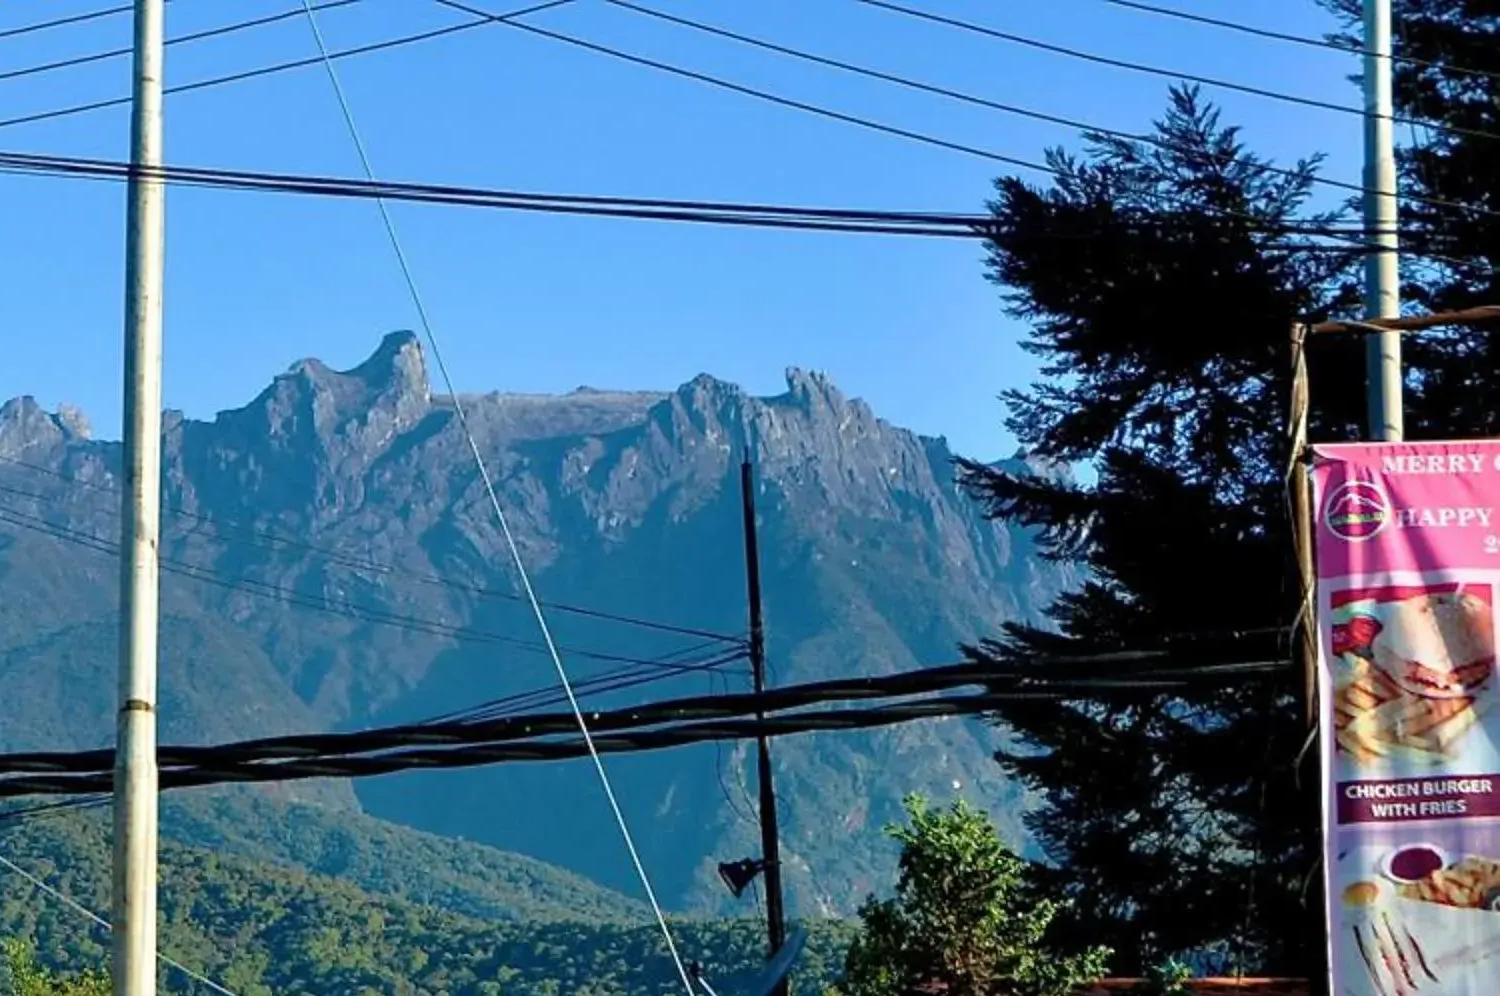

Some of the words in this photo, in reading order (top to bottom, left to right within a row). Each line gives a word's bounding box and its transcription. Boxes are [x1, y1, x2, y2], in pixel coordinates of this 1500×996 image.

[1381, 453, 1486, 474] MERRY
[1397, 506, 1493, 527] HAPPY
[1345, 782, 1419, 799] CHICKEN
[1423, 779, 1493, 795] BURGER
[1371, 803, 1417, 818] WITH
[1419, 800, 1467, 815] FRIES
